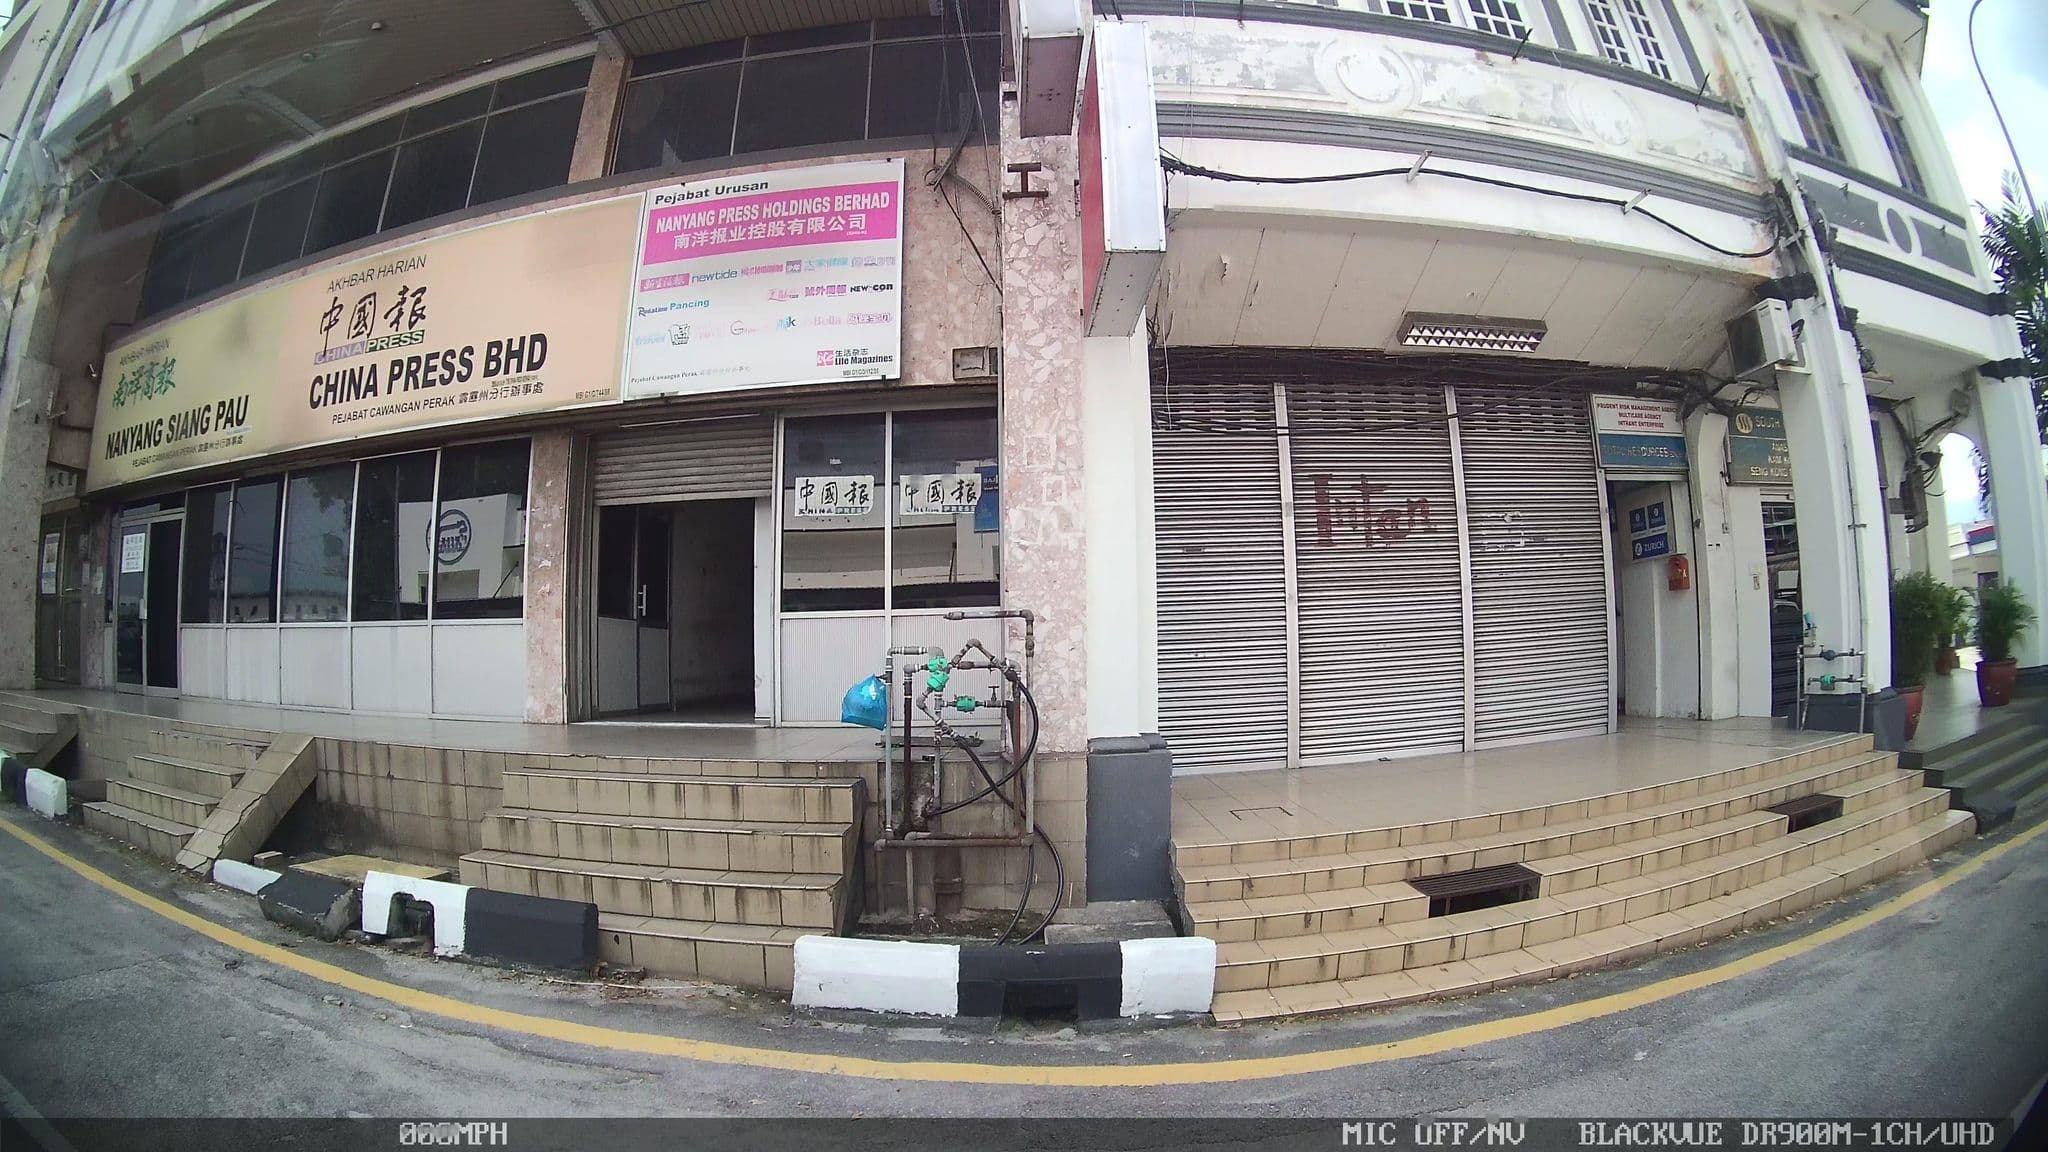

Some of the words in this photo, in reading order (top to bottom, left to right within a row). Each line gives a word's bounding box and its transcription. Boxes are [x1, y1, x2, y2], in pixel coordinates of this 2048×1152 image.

[655, 189, 710, 205] Pejabat
[715, 182, 769, 196] Urusan
[656, 210, 716, 234] NANYANG
[718, 204, 760, 225] PRESS
[762, 196, 831, 219] HOLDINGS
[834, 192, 890, 212] BERHAD
[673, 213, 866, 250] 南洋报业控股有限公司
[327, 268, 375, 293] AKHBAR
[377, 254, 427, 279] HARIAN
[691, 269, 738, 283] newtide
[319, 284, 428, 358] 中國報
[670, 299, 710, 310] Pancing
[365, 330, 425, 353] PRESS
[310, 363, 378, 409] CHINA
[387, 346, 474, 394] PRESS
[483, 333, 548, 378] BHD
[850, 355, 893, 365] Magazines
[332, 408, 369, 425] PEJABAT
[369, 400, 421, 417] CAWANGAN
[422, 395, 456, 409] PERAK
[105, 418, 164, 460] NANYANG
[166, 404, 211, 443] SIANG
[214, 395, 249, 431] PAU
[800, 479, 870, 512] 中國報
